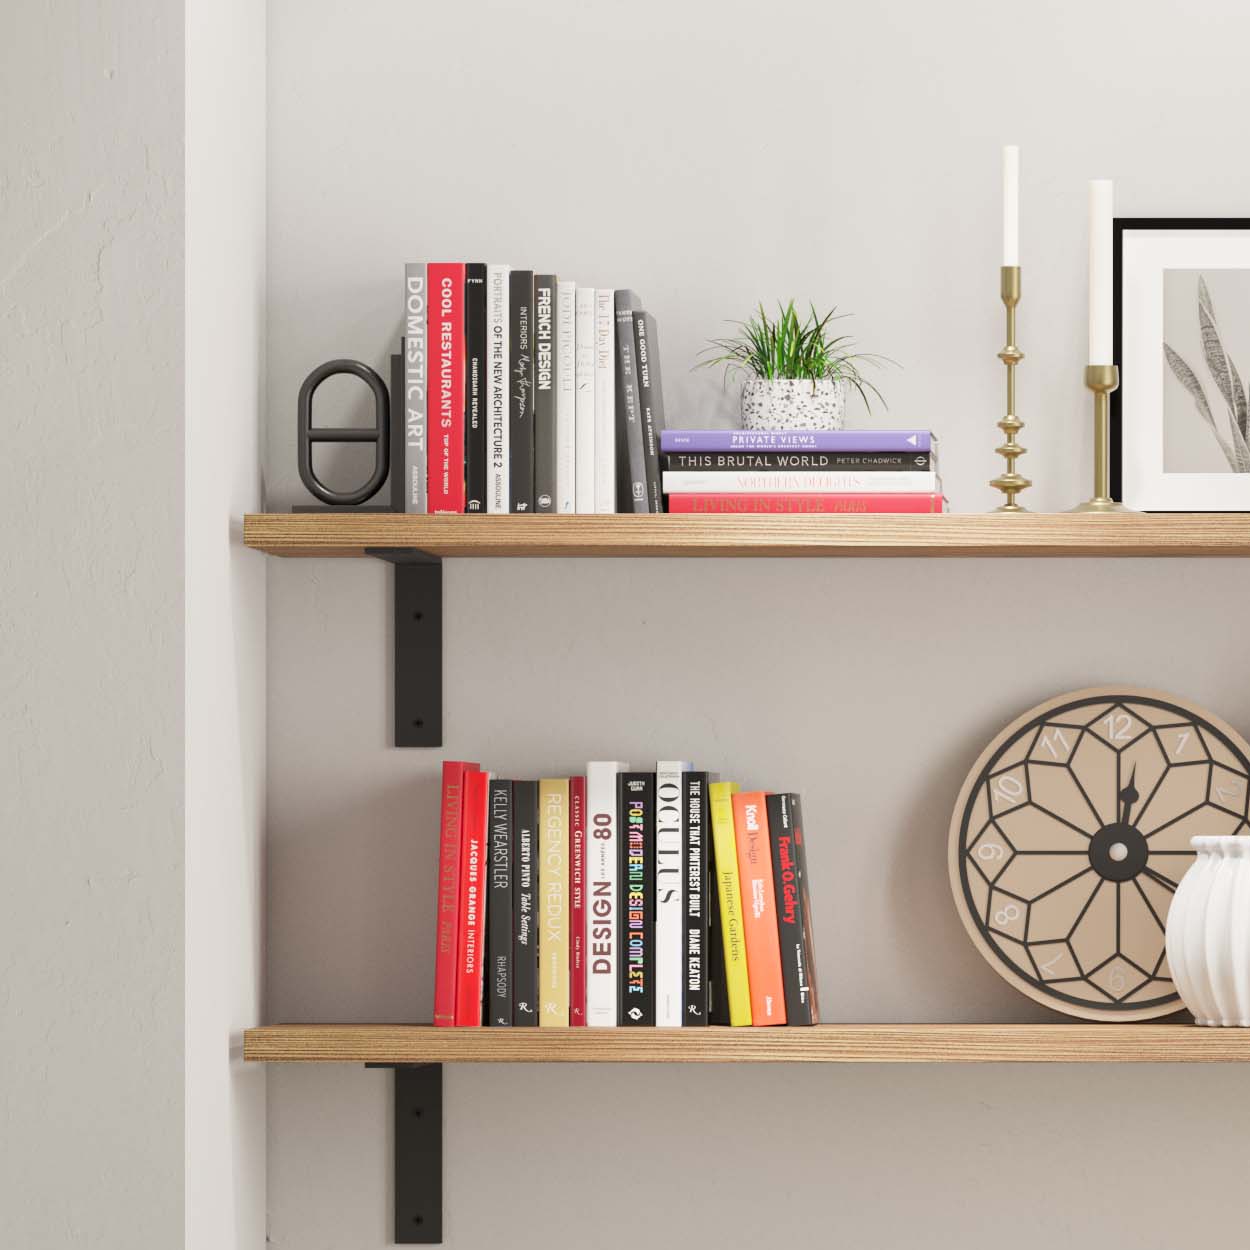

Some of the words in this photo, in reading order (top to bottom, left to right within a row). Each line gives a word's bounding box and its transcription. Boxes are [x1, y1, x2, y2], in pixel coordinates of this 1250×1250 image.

[441, 278, 452, 318] COOL
[494, 272, 503, 324] PORTRAITS
[538, 288, 552, 340] FRENCH
[408, 276, 424, 400] DOMESTIC
[494, 326, 503, 339] OF
[520, 306, 528, 350] INTERIORS
[494, 341, 503, 359] THE
[639, 338, 647, 363] GOOD
[441, 322, 452, 428] RESTAURANTS
[494, 361, 503, 384] NEW
[538, 343, 552, 390] DESIGN
[641, 364, 650, 388] TURN
[408, 408, 424, 451] ART
[494, 386, 503, 460] ARCHITECTURE
[443, 448, 448, 457] OF
[732, 436, 776, 444] PRIVATE
[781, 436, 815, 444] VIEWS
[679, 456, 711, 466] THIS
[718, 456, 772, 466] BRUTAL
[777, 456, 828, 466] WORLD
[692, 496, 748, 512] LIVING
[754, 496, 770, 512] IN
[776, 496, 824, 512] STYLE
[1040, 728, 1070, 758] 11
[1103, 714, 1133, 740] 12
[1175, 732, 1190, 755] 1
[688, 780, 700, 796] THE
[993, 775, 1024, 804] 10
[444, 784, 460, 838] LIVING
[494, 789, 507, 820] KELLY
[688, 798, 700, 824] HOUSE
[745, 804, 758, 830] Knoll
[546, 794, 562, 877] REGENCY
[592, 813, 612, 840] 80
[688, 826, 700, 846] THAT
[444, 843, 458, 861] IN
[494, 823, 508, 888] WEARSTLER
[520, 829, 530, 862] ALBERTO
[574, 830, 582, 884] GREENWICH
[657, 783, 680, 904] OCULUS
[747, 832, 759, 864] Design
[778, 836, 794, 868] Frank
[468, 839, 478, 882] JACQUES
[520, 864, 530, 888] PINTO
[688, 848, 700, 892] PINTEREST
[442, 863, 456, 912] STYLE
[782, 870, 794, 884] O.
[467, 886, 478, 926] GRANGE
[520, 892, 530, 913] Table
[546, 882, 562, 942] REDUX
[574, 886, 582, 909] STYLE
[628, 884, 644, 928] DESIGN
[688, 894, 700, 917] BUILT
[782, 884, 797, 924] Gehry
[518, 914, 530, 945] Settings
[592, 881, 612, 974] DESIGN
[722, 872, 735, 916] Japanese
[729, 918, 741, 961] Gardens
[994, 904, 1020, 925] 8
[466, 929, 476, 974] INTERIORS
[688, 928, 700, 955] DIANE
[497, 956, 507, 998] RHAPSODY
[628, 932, 644, 993] COMPLETE
[688, 956, 700, 991] KEATON
